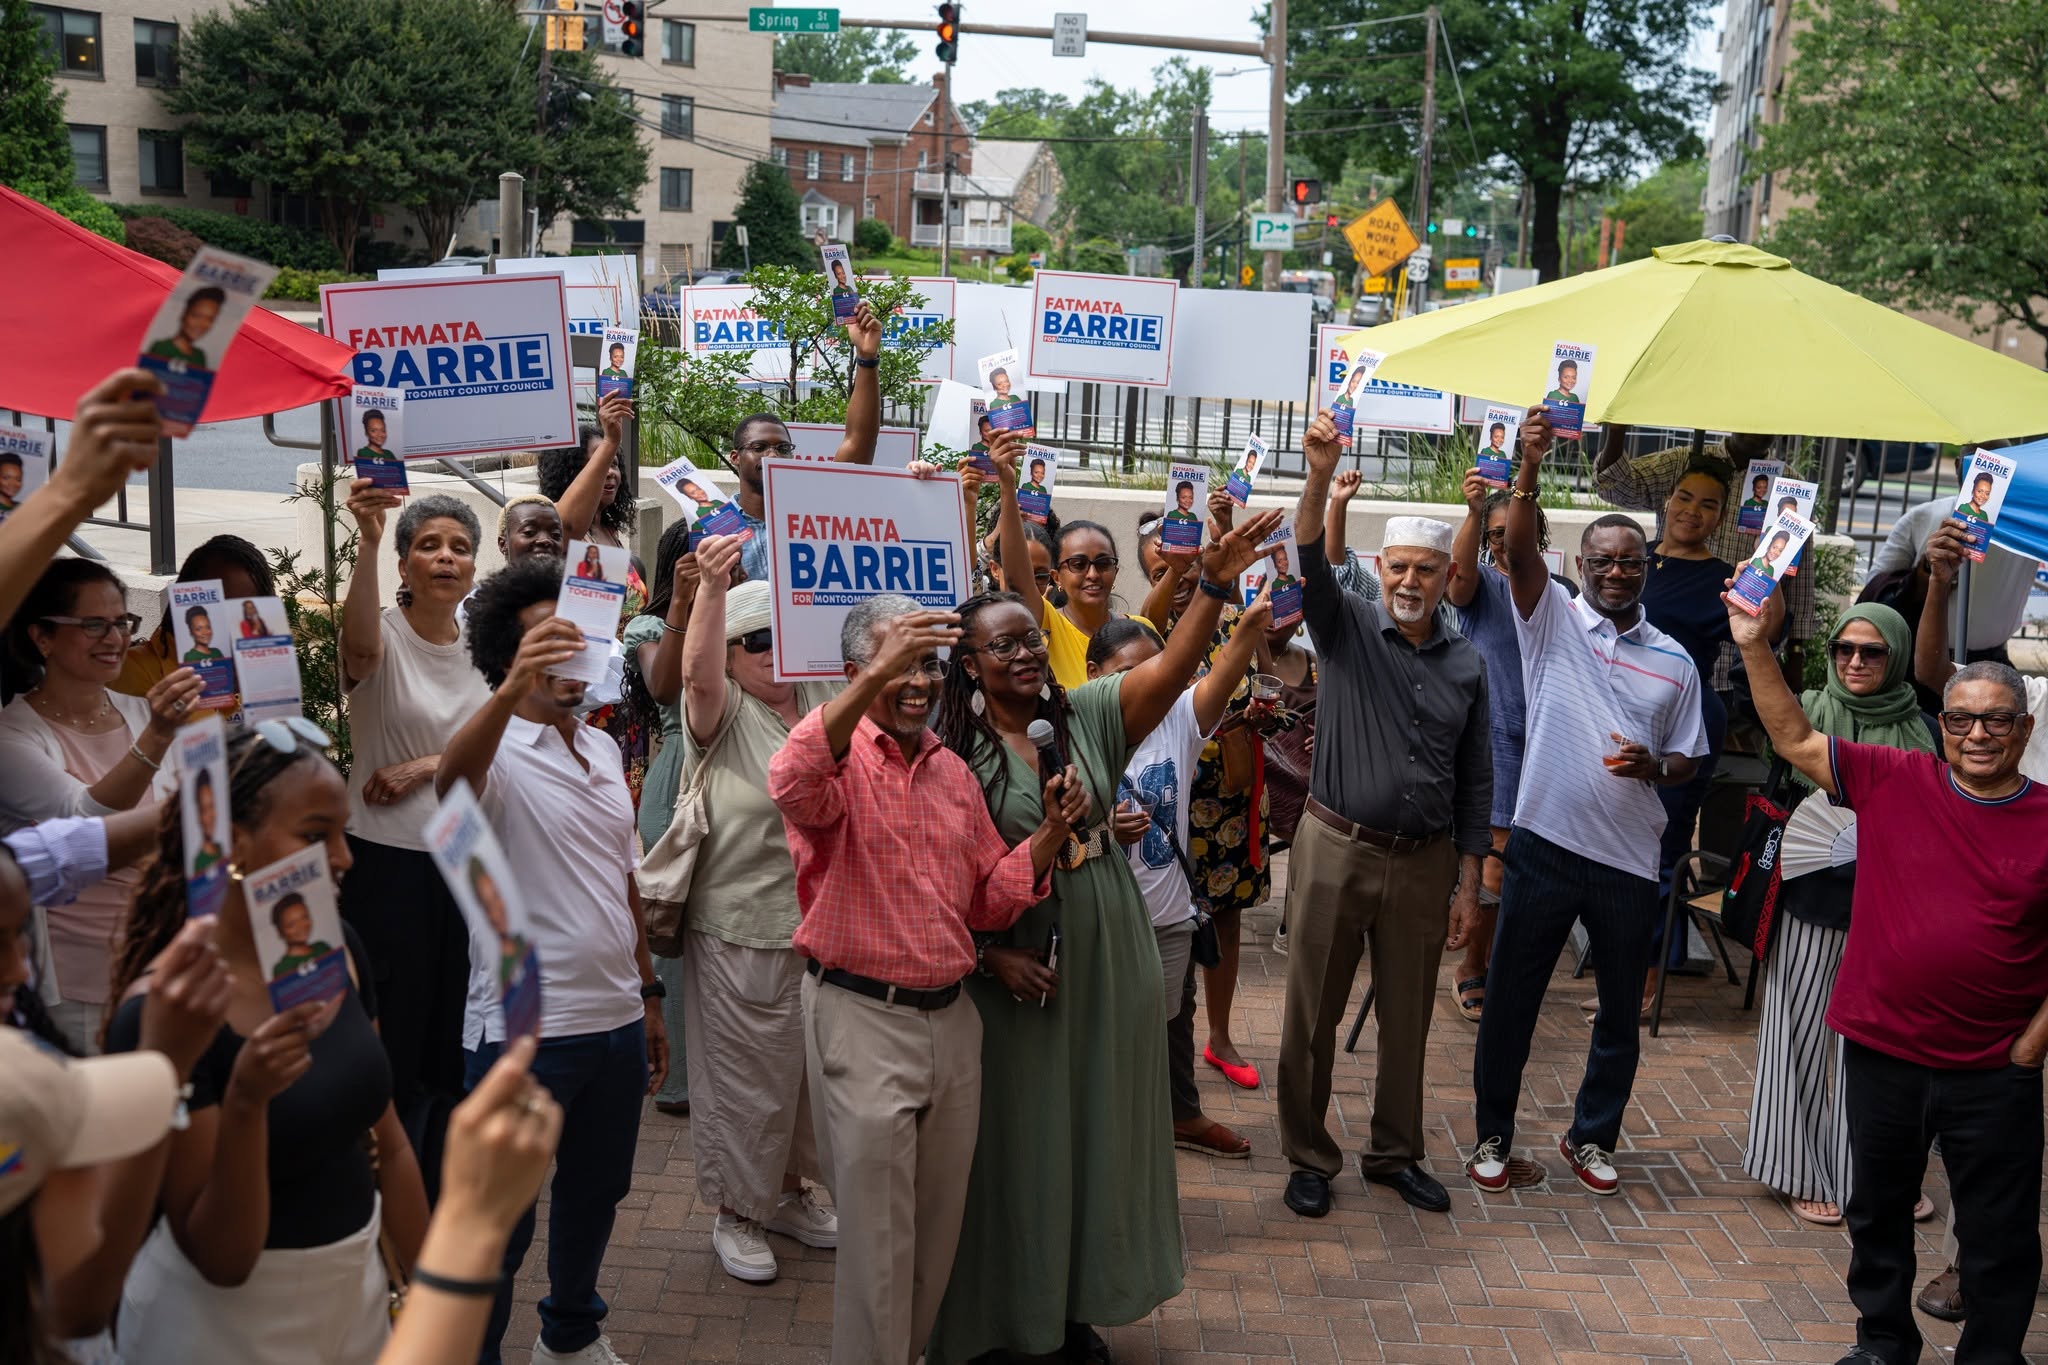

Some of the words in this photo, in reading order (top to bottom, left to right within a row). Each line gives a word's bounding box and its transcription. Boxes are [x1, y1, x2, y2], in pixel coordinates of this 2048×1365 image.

[759, 13, 799, 30] Spring
[817, 11, 827, 21] St
[1063, 17, 1078, 26] NO
[1369, 217, 1400, 232] ROAD
[1366, 231, 1397, 246] WORK
[825, 250, 845, 259] BARRIE
[1377, 248, 1400, 261] MILE
[1408, 263, 1428, 277] 29
[1045, 297, 1123, 315] FATMATA
[1043, 311, 1157, 342] BARRIE
[349, 321, 484, 349] FATMATA
[606, 333, 634, 342] BARRIE
[1057, 337, 1101, 345] MONTGOMERY
[1129, 342, 1156, 350] COUNCIL
[1555, 348, 1590, 360] BARRIE
[352, 340, 544, 389] BARRIE
[406, 388, 455, 399] TGOMERY
[458, 385, 500, 395] COUNTY
[502, 381, 547, 392] COUNCIL
[1412, 391, 1438, 399] COUNCIL
[356, 395, 397, 408] BARRIE
[1488, 413, 1516, 423] BARRIE
[0, 437, 42, 454] ARRIE
[1249, 438, 1265, 454] BARRIE
[1028, 448, 1055, 460] BARRIE
[1751, 465, 1779, 474] BARRIE
[1974, 457, 2009, 476] BARRIE
[660, 464, 691, 485] BARRIE
[1172, 470, 1204, 480] BARRIE
[1775, 484, 1811, 498] BARRIE
[787, 514, 900, 543] FATMATA
[1779, 515, 1807, 538] BARRIE
[789, 543, 949, 591] BARRIE
[174, 591, 217, 604] BARRIE
[568, 587, 618, 601] TOGETHER
[794, 594, 812, 603] FOR
[241, 647, 289, 658] TOGETHER
[253, 861, 322, 901] BARRIE
